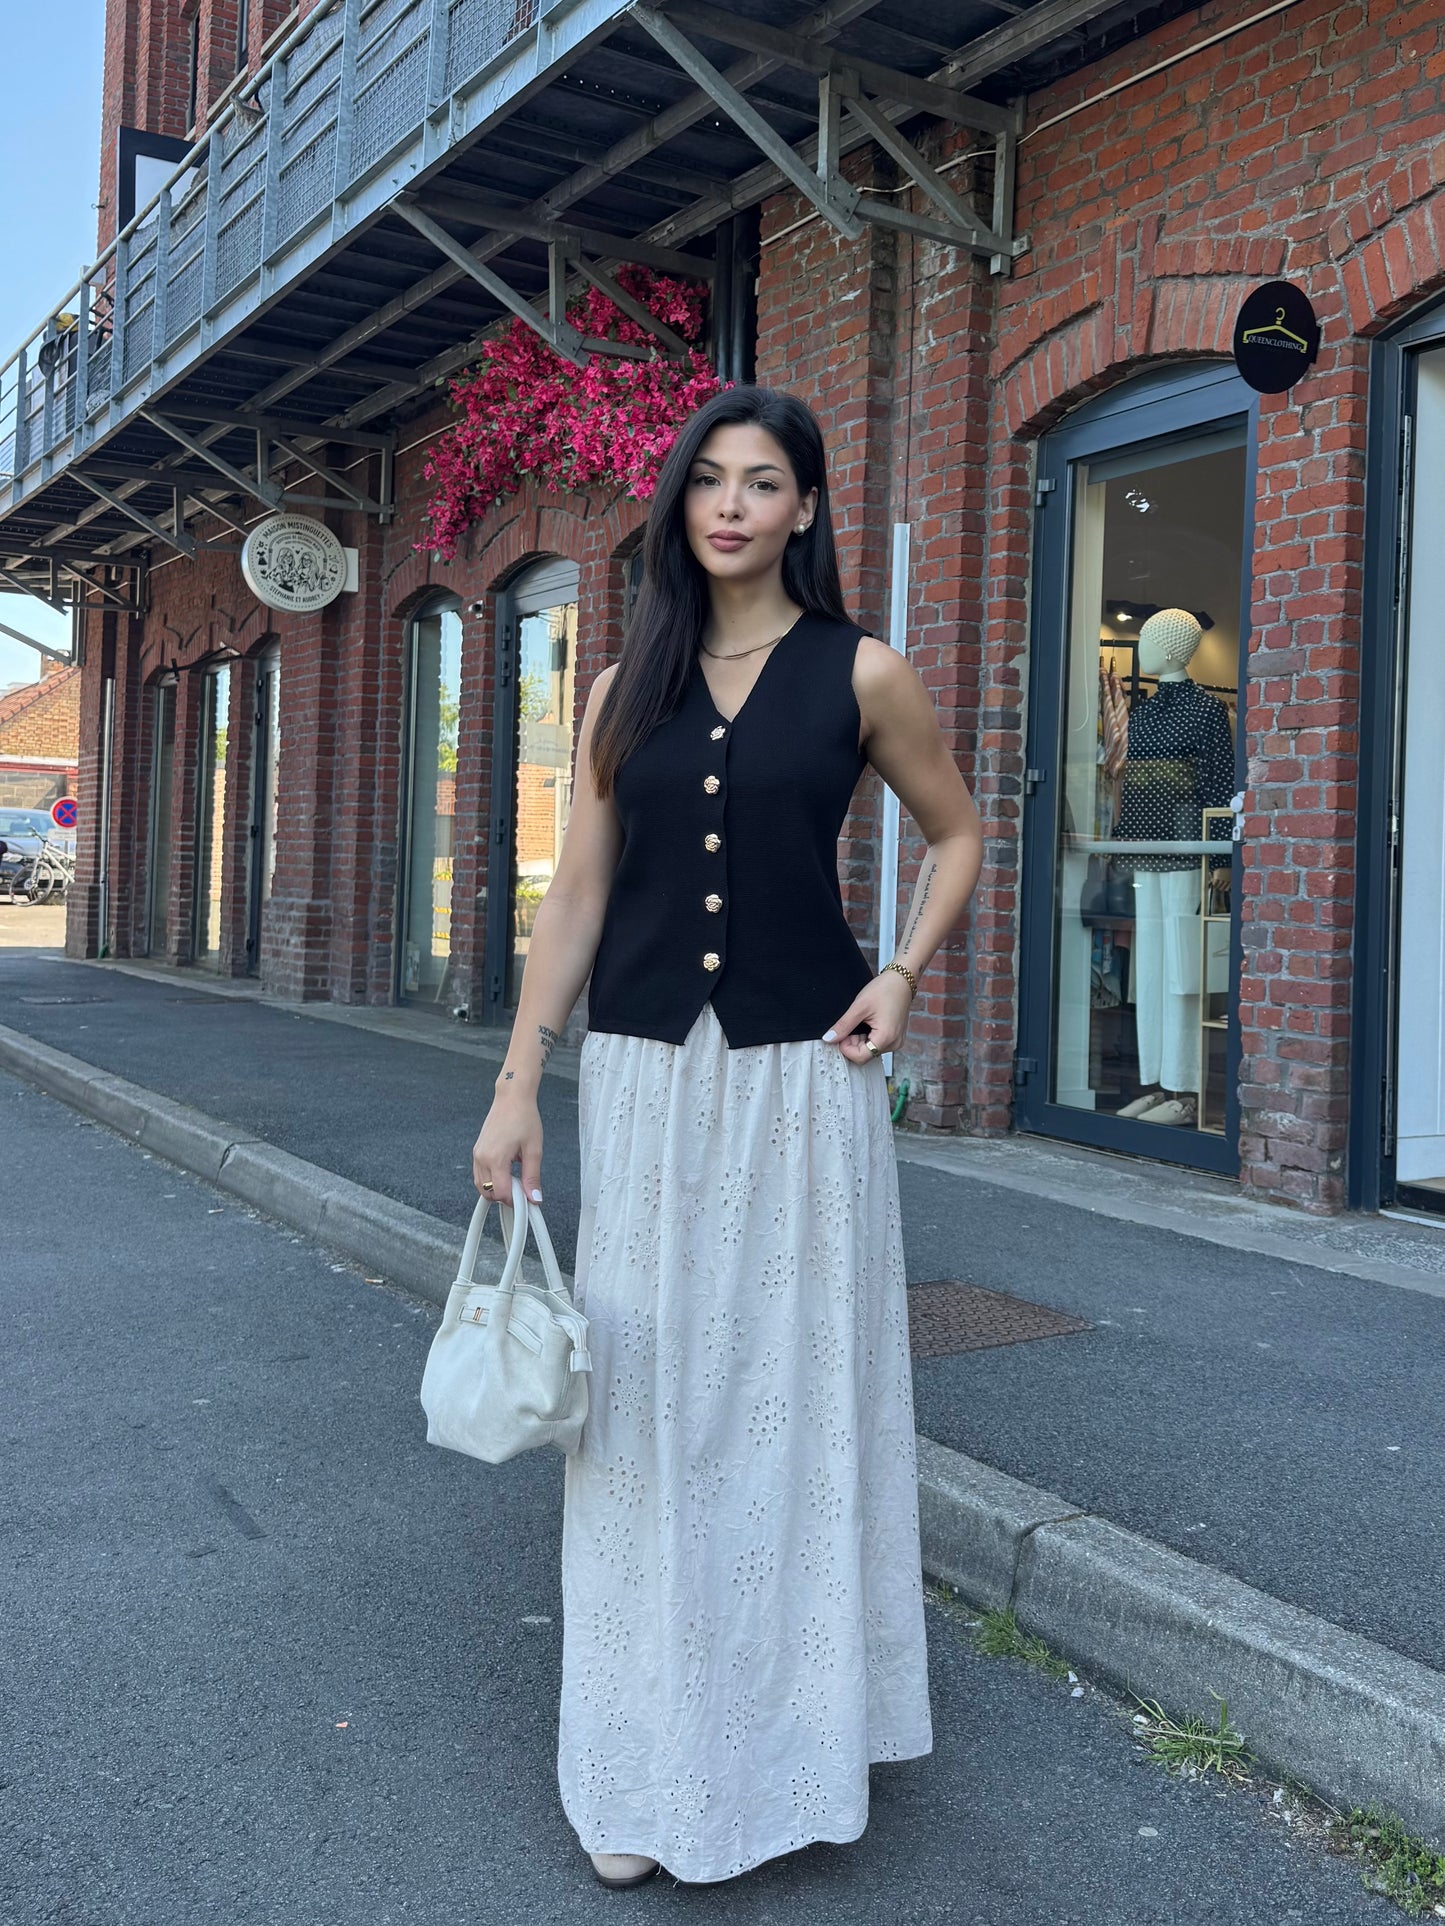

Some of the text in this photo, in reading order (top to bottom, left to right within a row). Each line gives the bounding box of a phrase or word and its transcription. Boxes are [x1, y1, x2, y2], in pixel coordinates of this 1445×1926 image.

[1248, 335, 1302, 350] QUEENCLOTHING
[262, 522, 287, 539] MAISON
[287, 521, 334, 548] MISTINGUETTES
